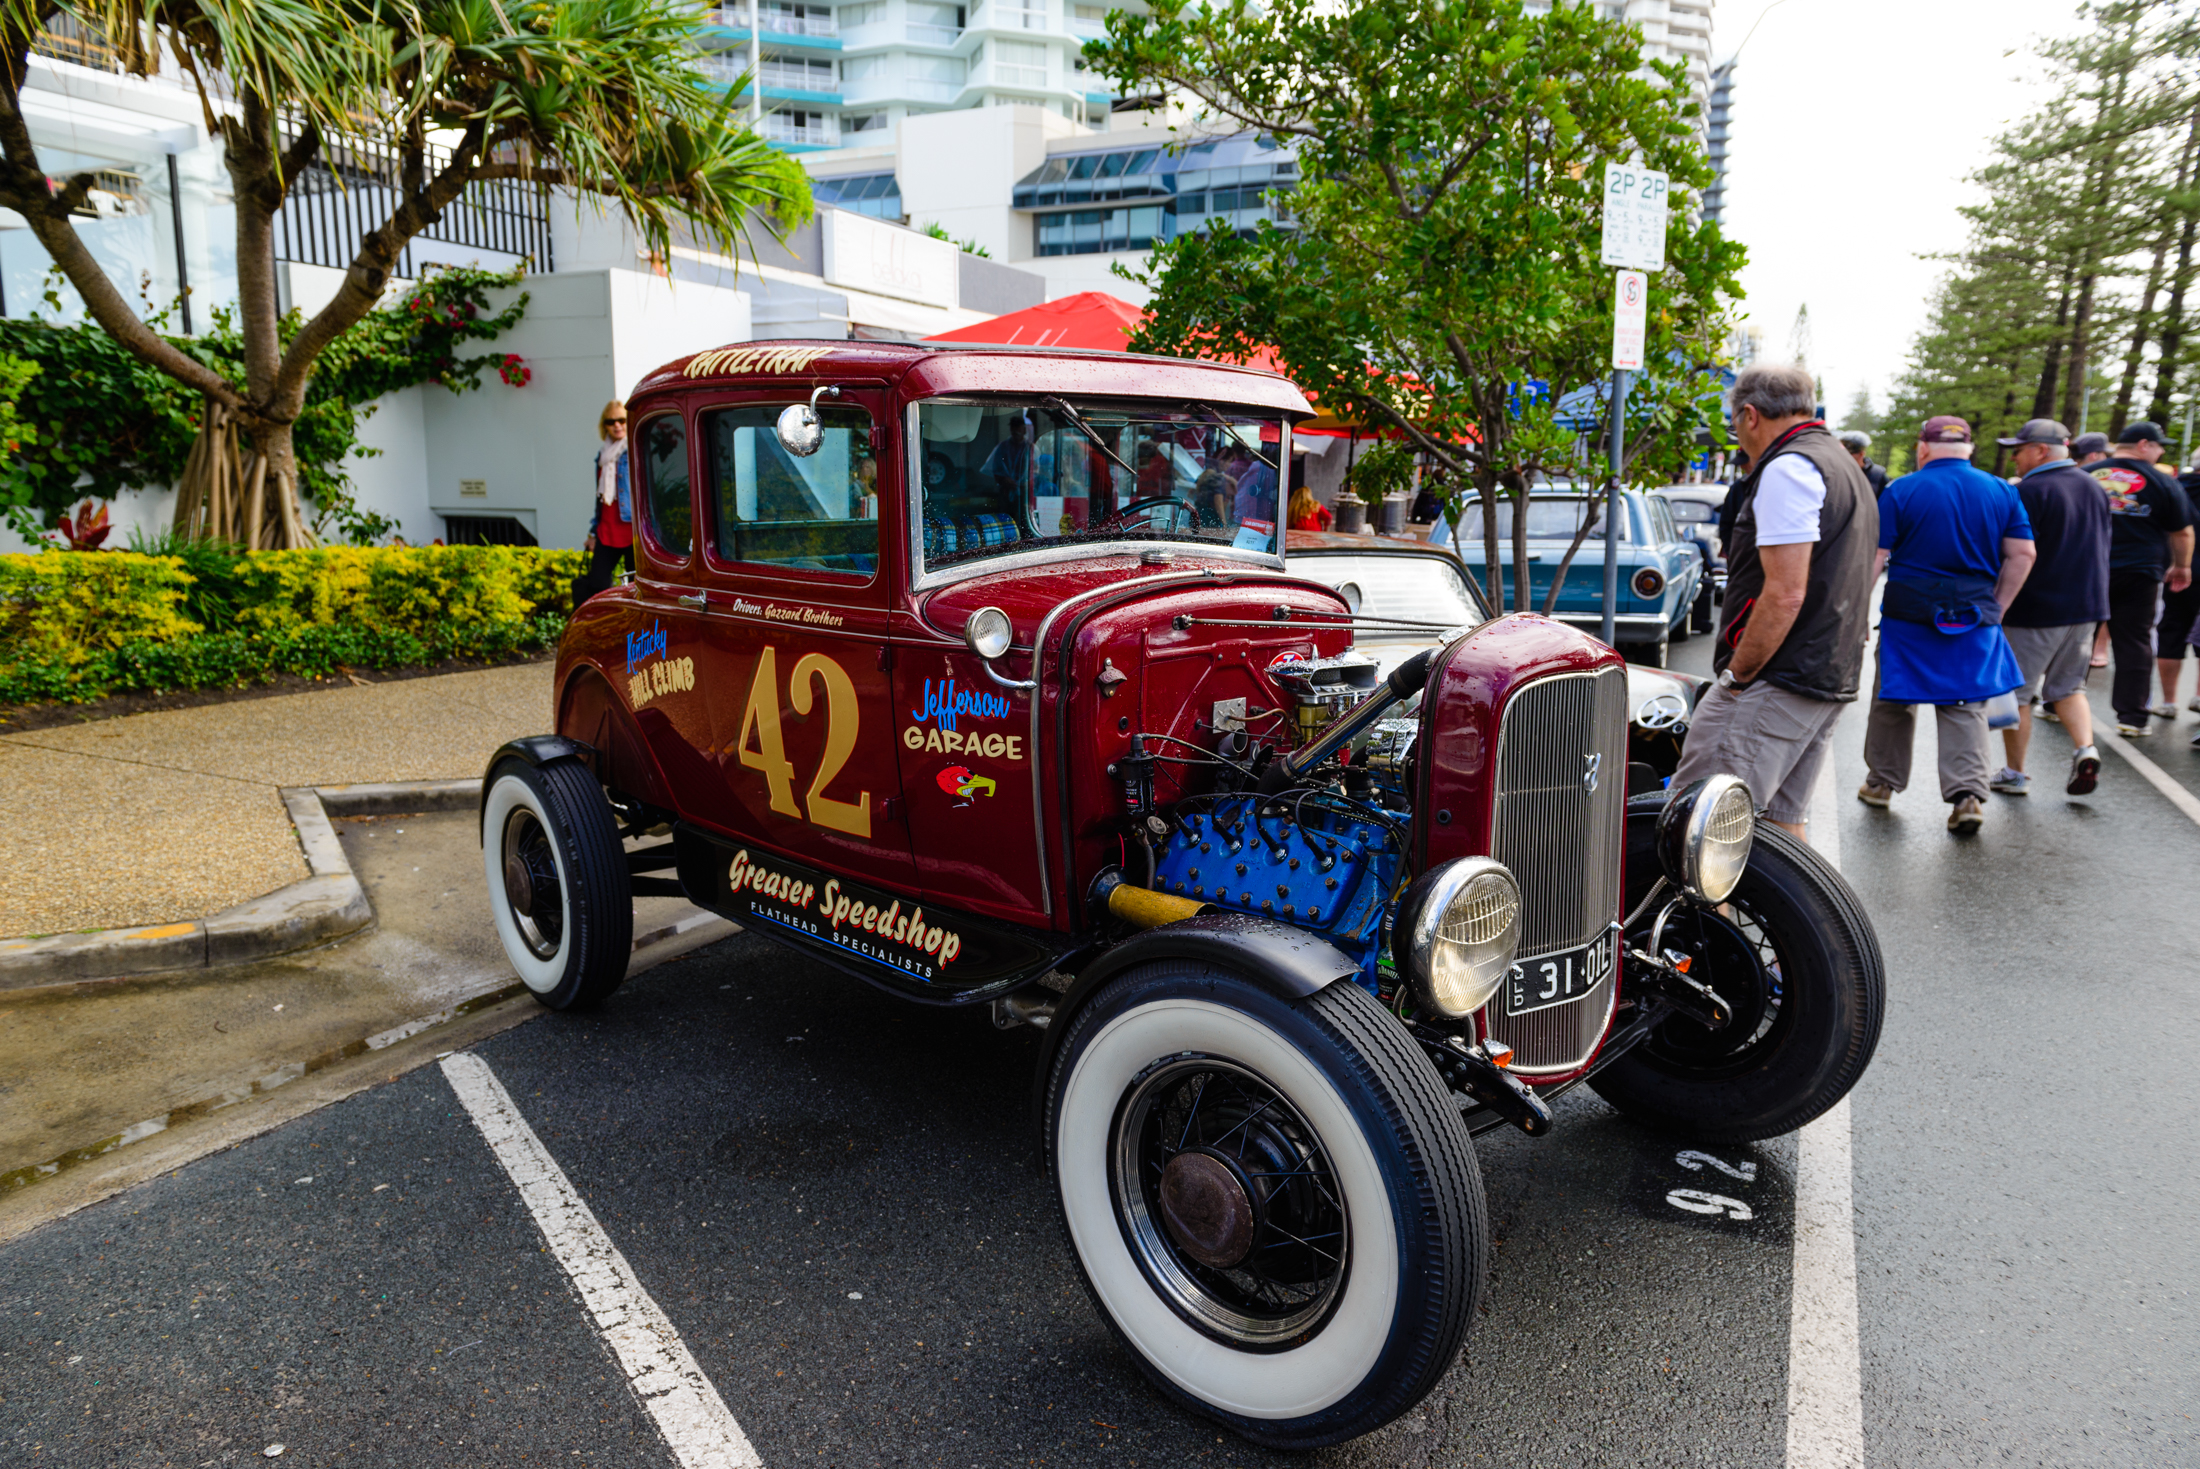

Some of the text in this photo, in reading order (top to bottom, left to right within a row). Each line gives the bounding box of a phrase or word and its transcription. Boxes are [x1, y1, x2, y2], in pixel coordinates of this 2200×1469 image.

[1609, 170, 1636, 195] 2P
[1641, 176, 1666, 200] 2P
[683, 346, 834, 379] RATTLETRAP
[733, 598, 844, 627] Drivers: Gazzard Brothers
[626, 618, 667, 675] Kentucky
[627, 656, 695, 709] HILL CLIMB
[911, 676, 1011, 732] Jefferson
[737, 645, 872, 839] 42
[903, 726, 1023, 760] GARAGE
[729, 849, 962, 970] Greaser Speedshop
[751, 901, 932, 978] FLATHEAD SPECIALISTS
[1665, 1150, 1759, 1221] 92
